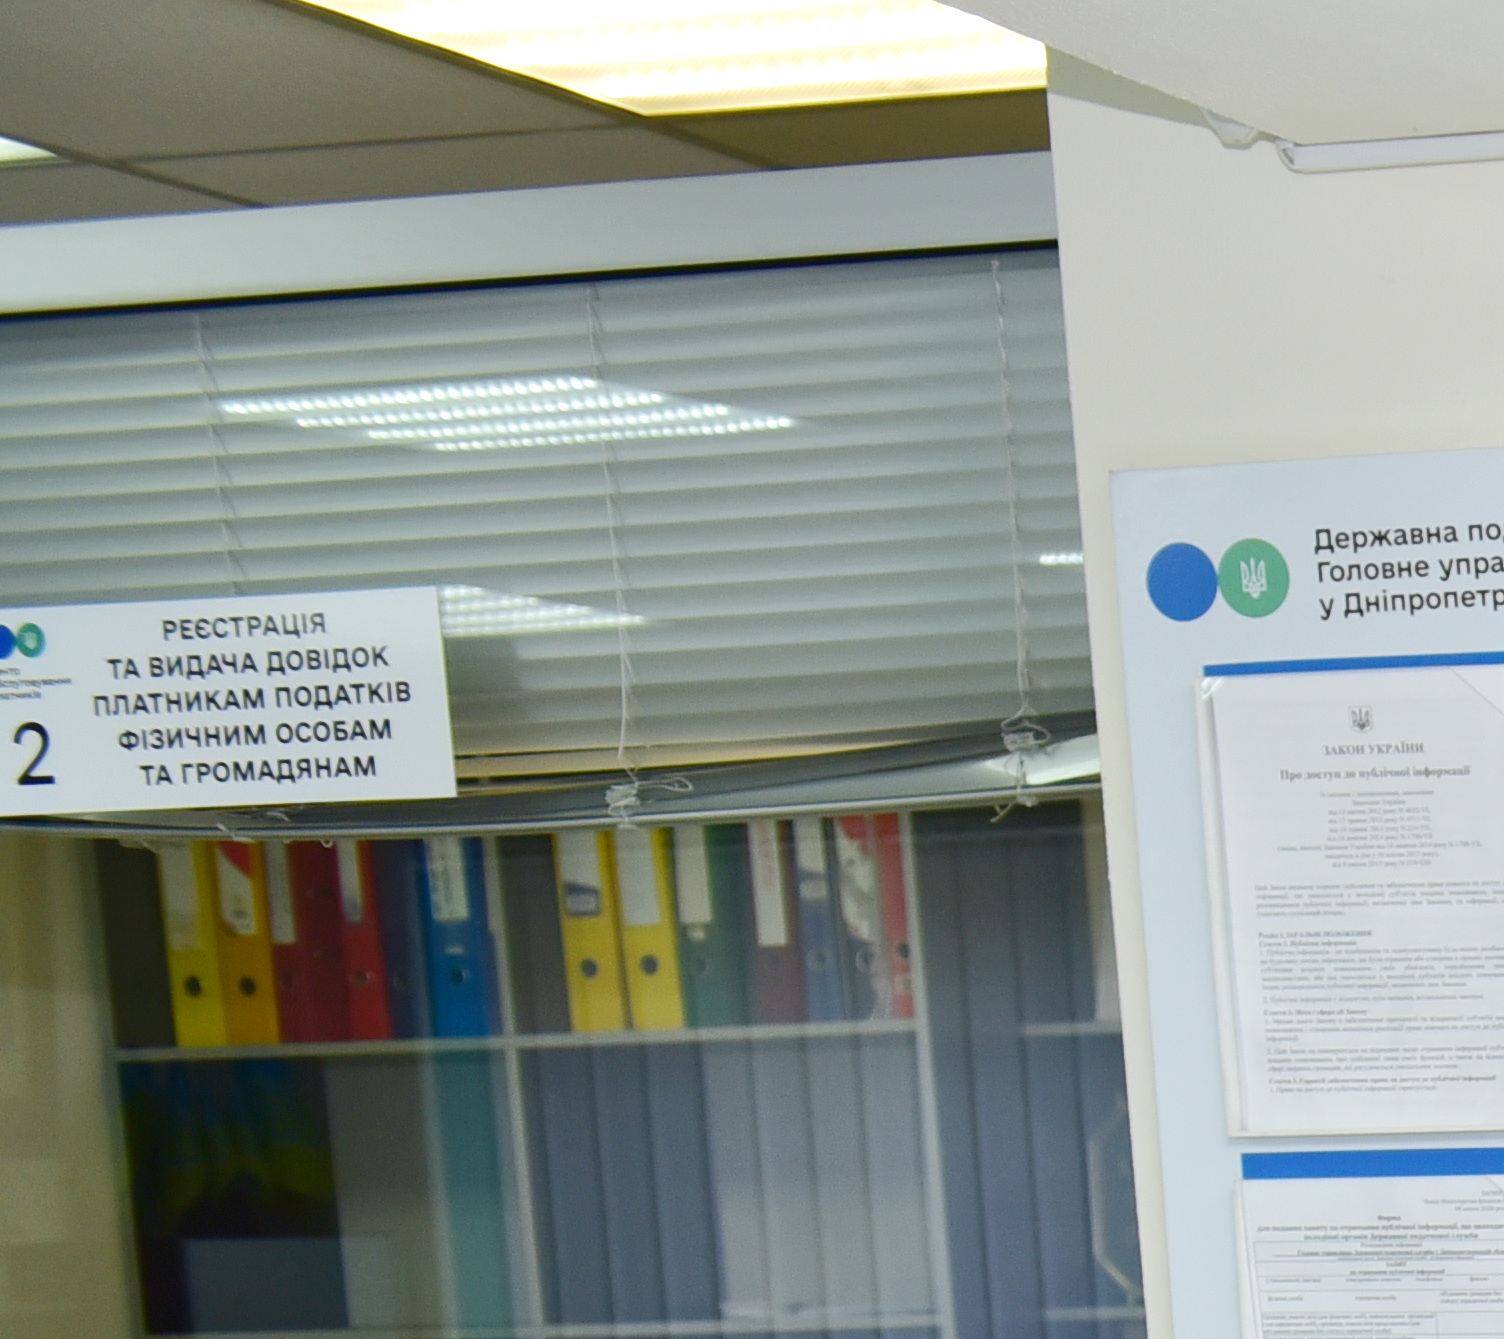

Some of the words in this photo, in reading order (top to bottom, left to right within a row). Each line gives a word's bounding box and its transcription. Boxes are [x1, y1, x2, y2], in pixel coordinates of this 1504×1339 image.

[1314, 525, 1459, 555] Державна
[1317, 560, 1430, 583] Головне
[1319, 598, 1334, 621] у
[162, 612, 326, 641] РЕЄСТРАЦІЯ
[106, 658, 141, 679] ТА
[148, 652, 259, 680] ВИДАЧА
[266, 646, 389, 676] ДОВІДОК
[93, 688, 265, 715] ПЛАТНИКАМ
[275, 681, 411, 710] ПОДАТКІВ
[118, 724, 266, 751] ФІЗИЧНИМ
[275, 718, 392, 744] ОСОБАМ
[1323, 744, 1366, 756] ЗАКОН
[1368, 741, 1425, 755] УКРАЇНИ
[13, 721, 56, 786] 2
[139, 764, 173, 785] ТА
[181, 755, 376, 784] ГРОМАДЯНАМ
